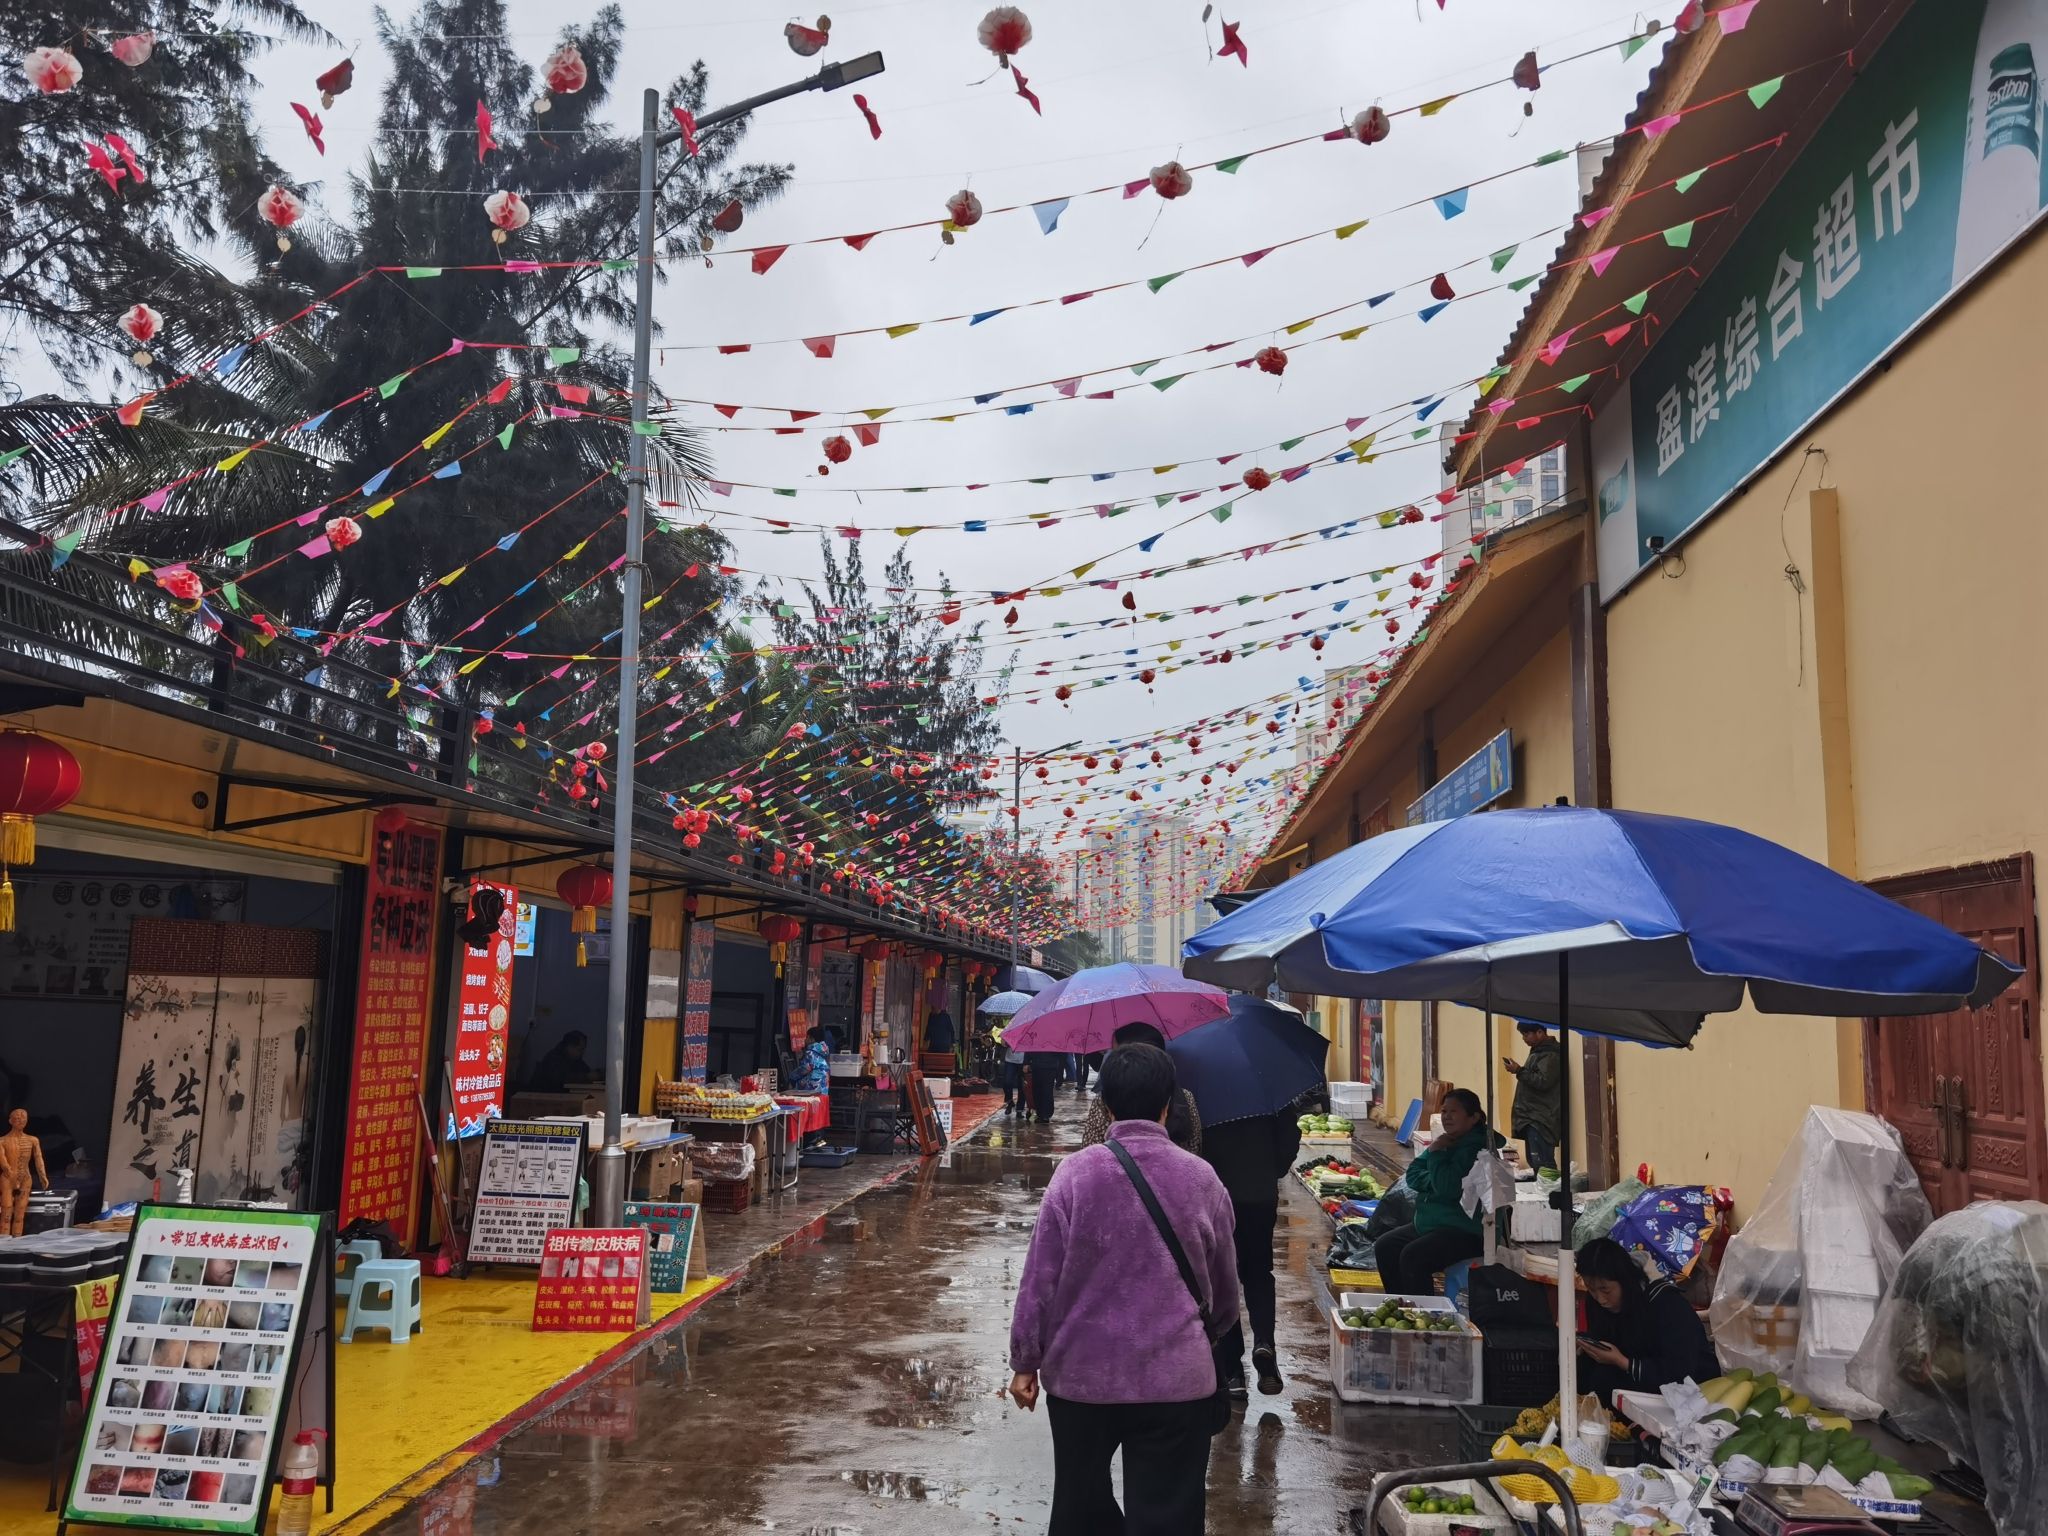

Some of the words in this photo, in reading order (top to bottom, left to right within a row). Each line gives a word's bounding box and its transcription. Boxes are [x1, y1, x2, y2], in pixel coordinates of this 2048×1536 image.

[1656, 107, 1920, 476] 盈滨综合超市
[489, 1124, 580, 1136] 太赫兹光照细胞修复仪
[170, 1230, 281, 1251] 常见皮肤病症状图
[1496, 1288, 1520, 1302] Lee
